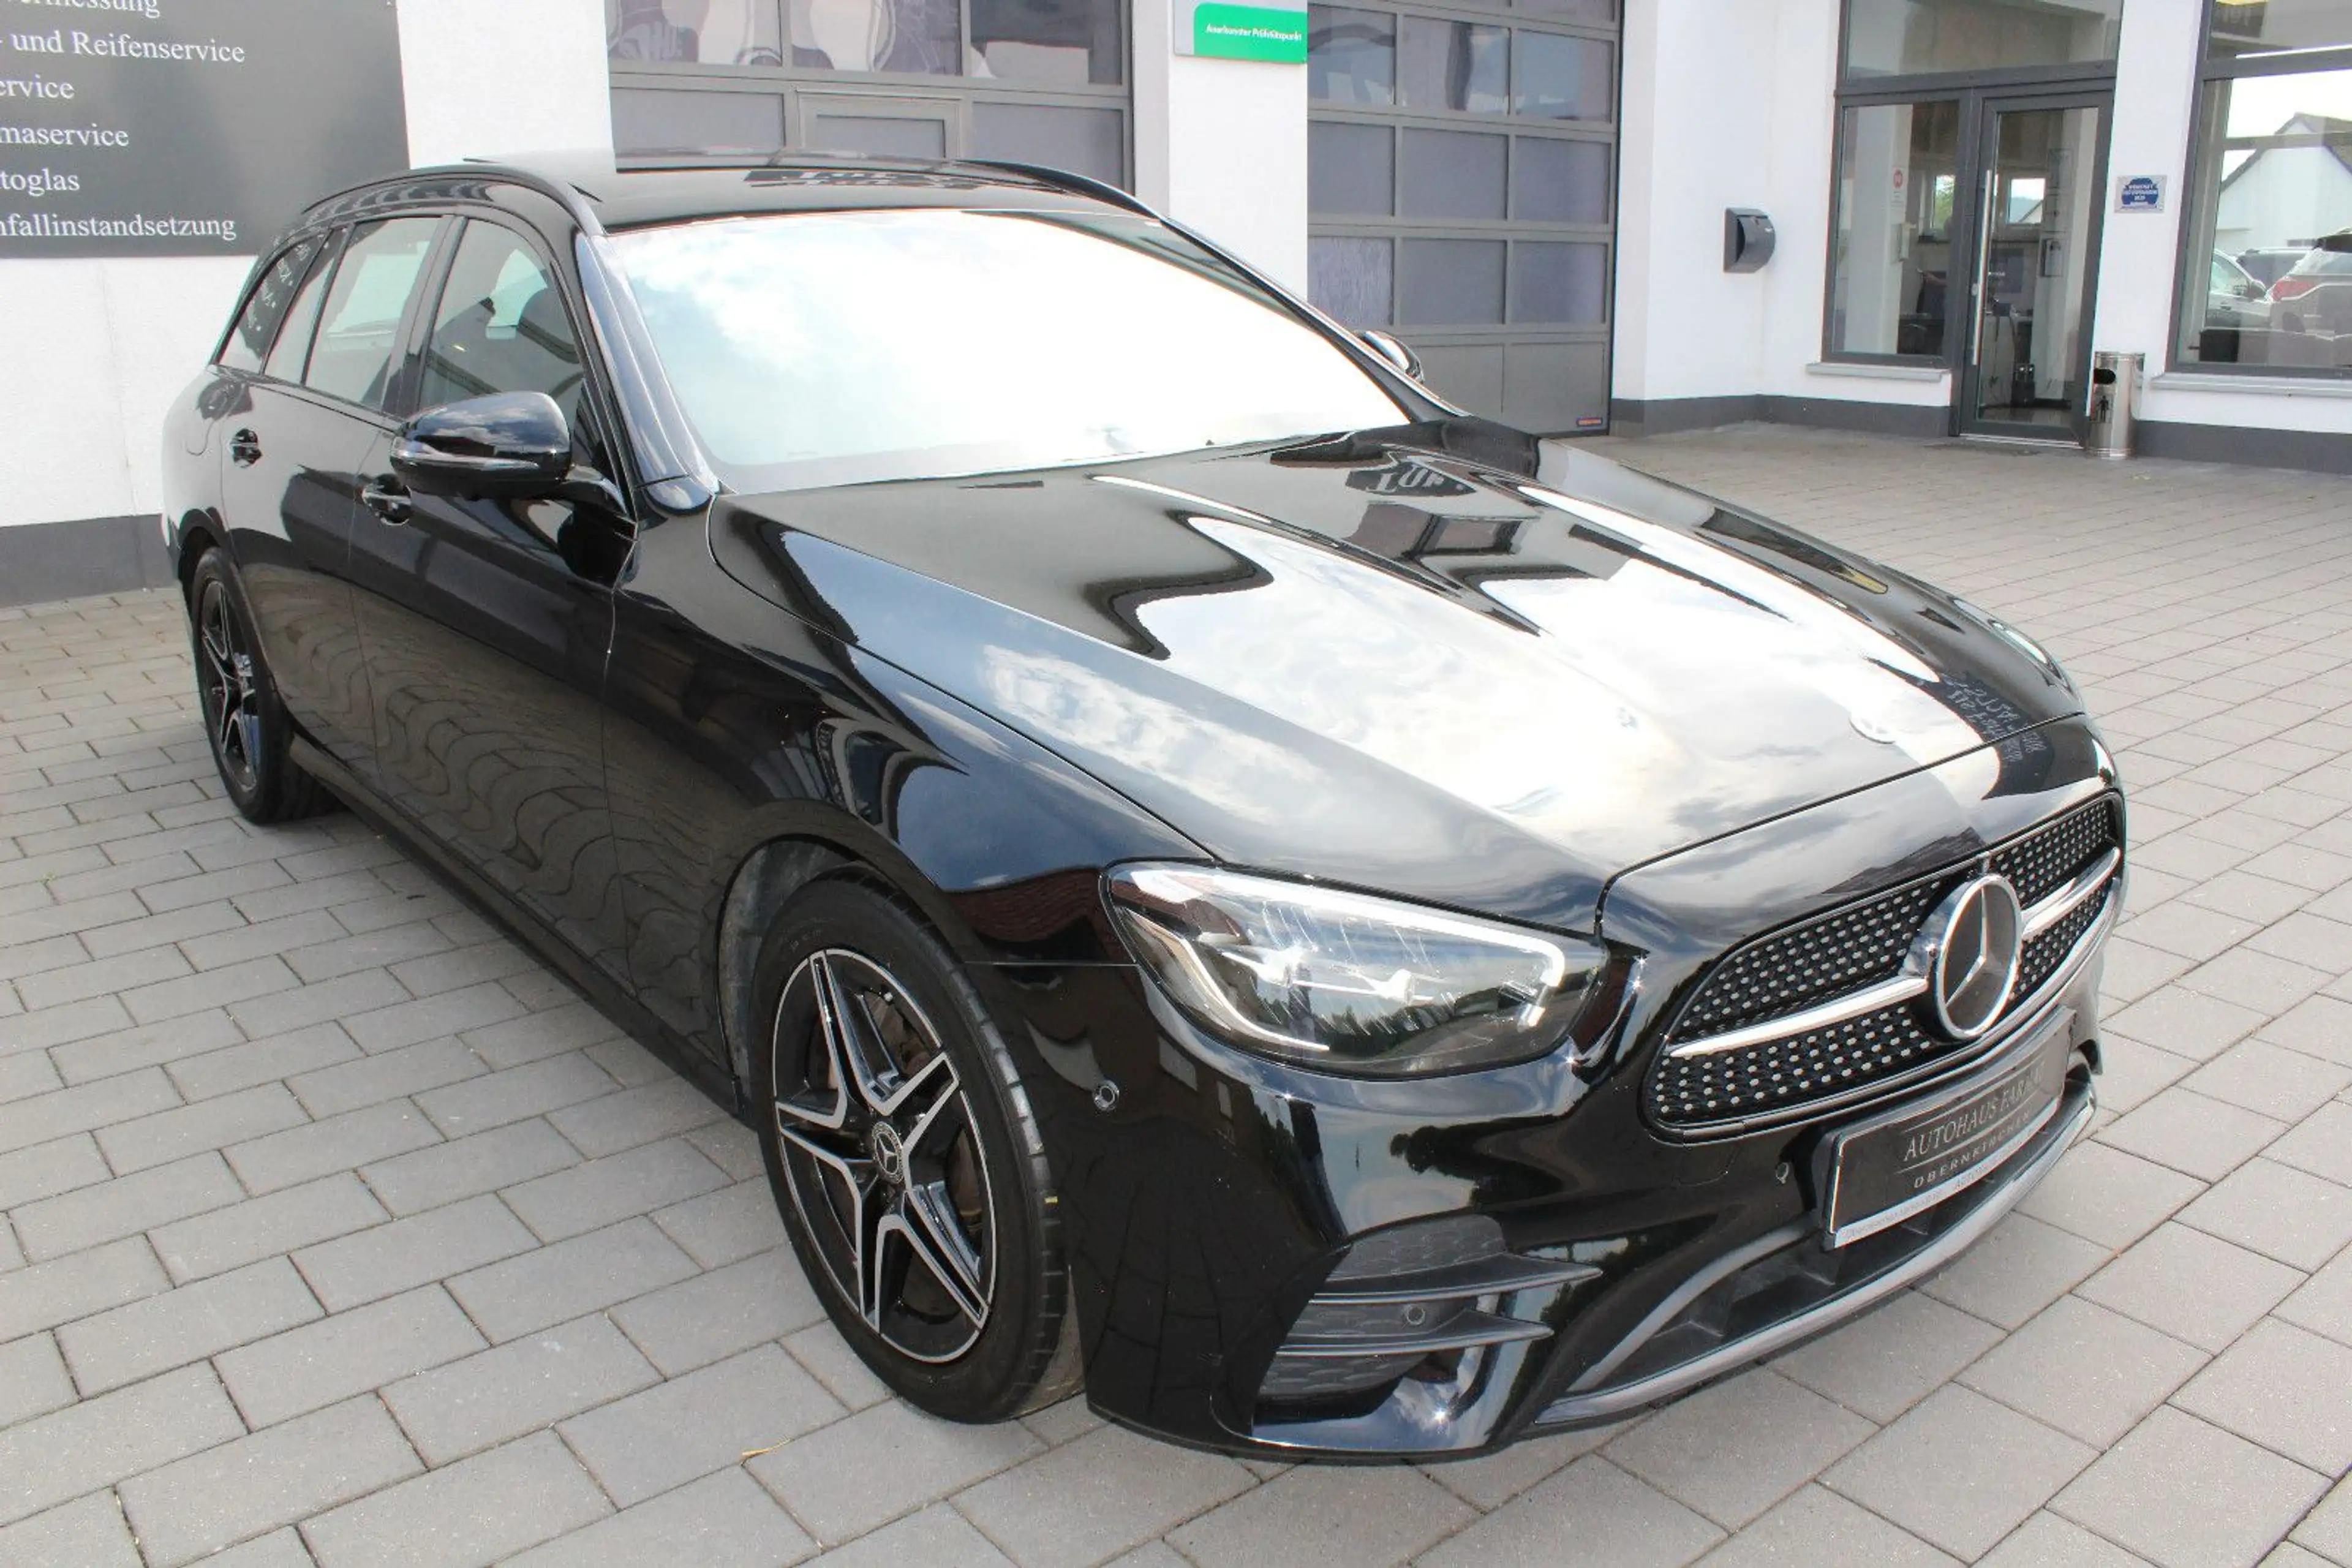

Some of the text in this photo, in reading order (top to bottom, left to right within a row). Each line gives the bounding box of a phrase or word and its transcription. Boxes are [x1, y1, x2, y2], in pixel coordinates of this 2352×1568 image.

[10, 30, 245, 61] und Reifenservice
[0, 167, 80, 197] toglas
[1904, 1096, 1997, 1162] AUTOHAUS
